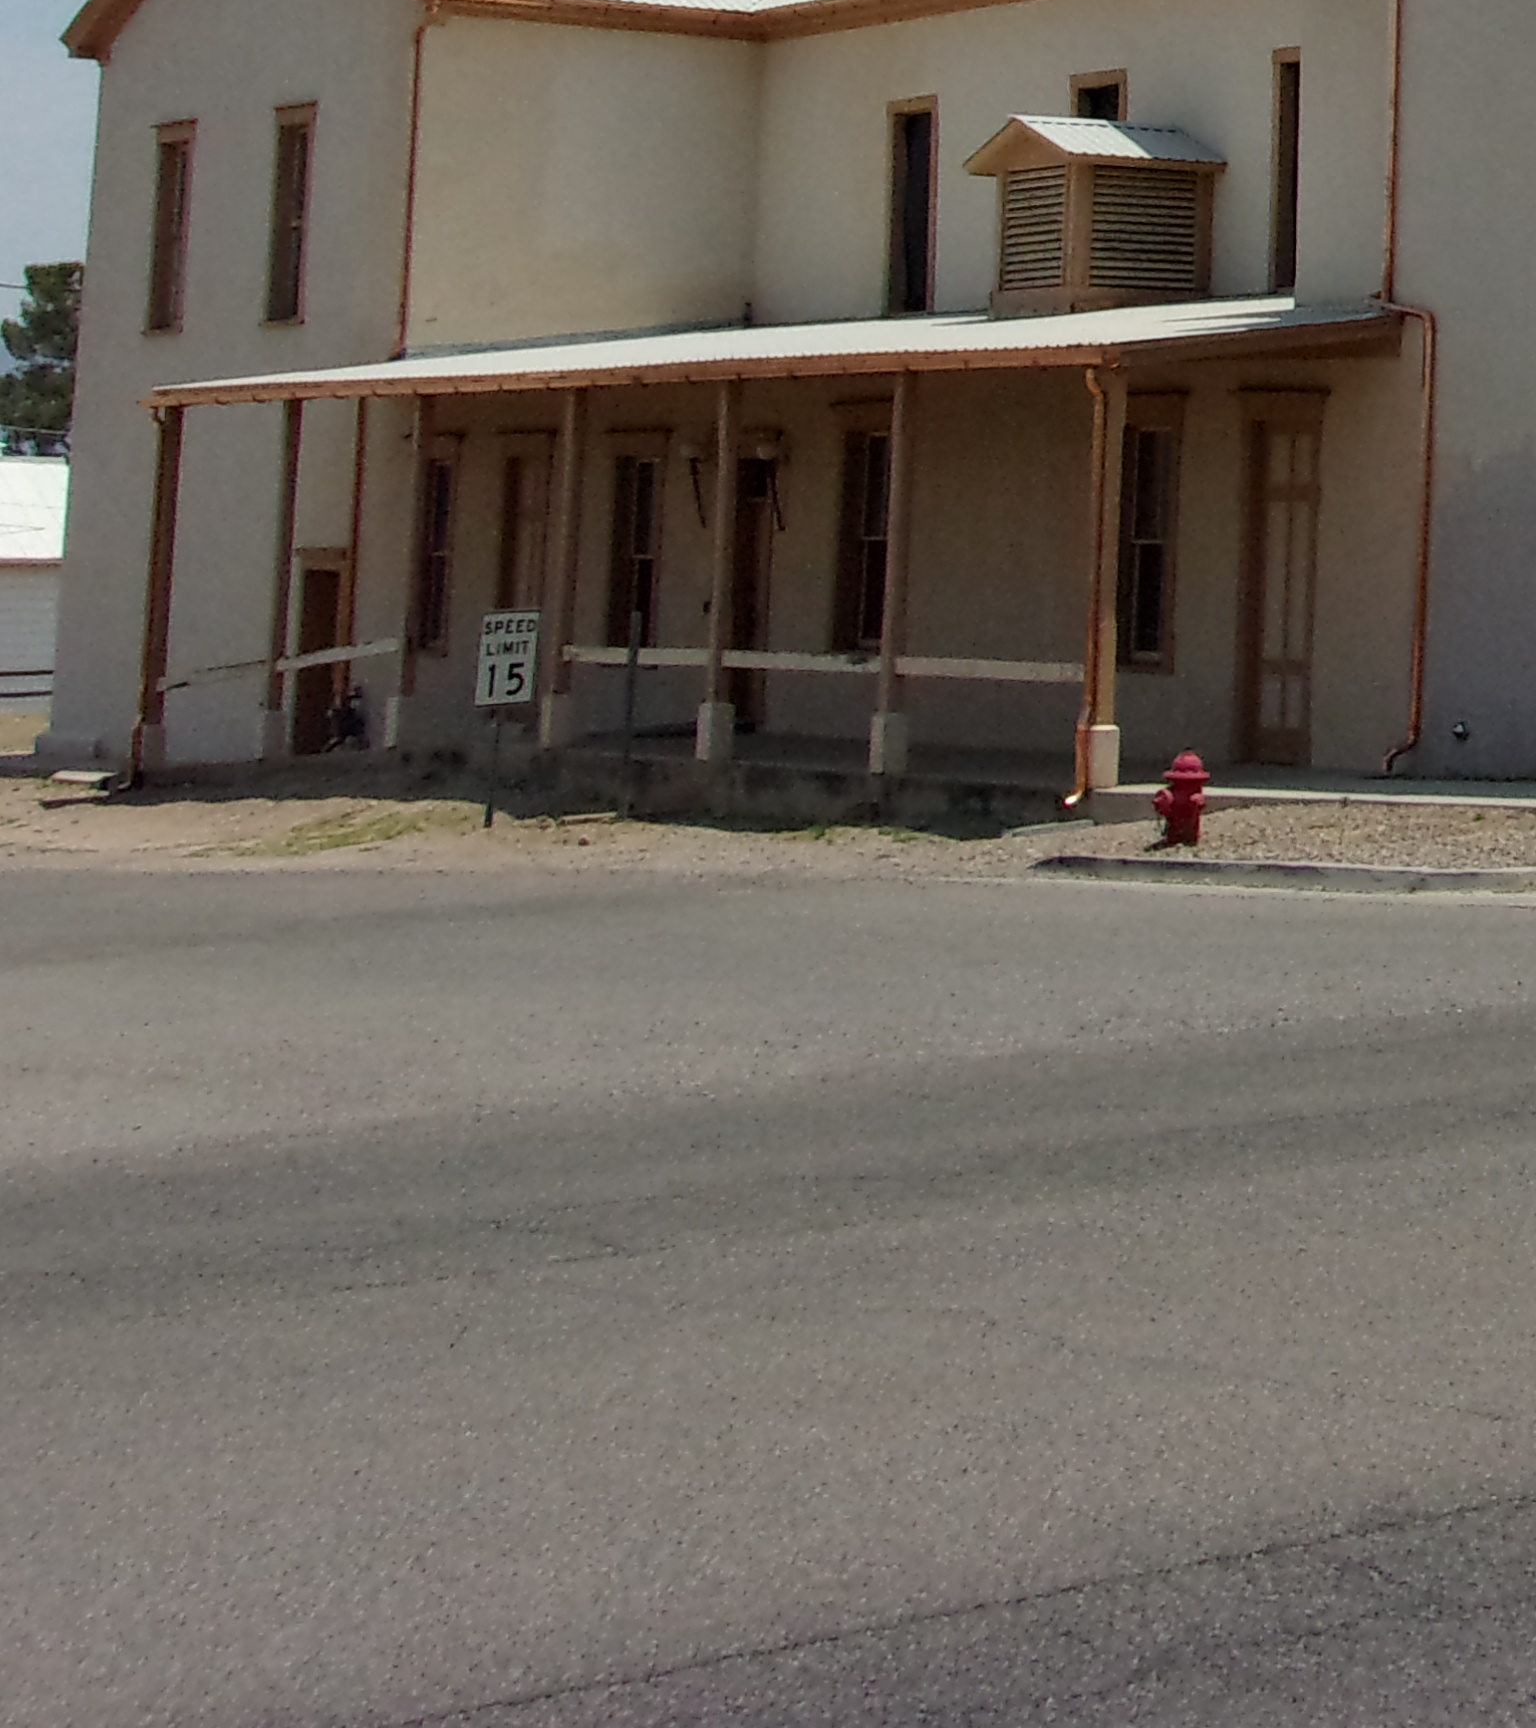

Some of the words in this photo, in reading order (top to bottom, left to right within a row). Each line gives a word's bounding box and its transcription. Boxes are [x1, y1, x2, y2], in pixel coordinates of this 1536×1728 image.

[484, 619, 537, 636] SPEED
[486, 640, 530, 657] LIMIT
[488, 662, 525, 699] 15
